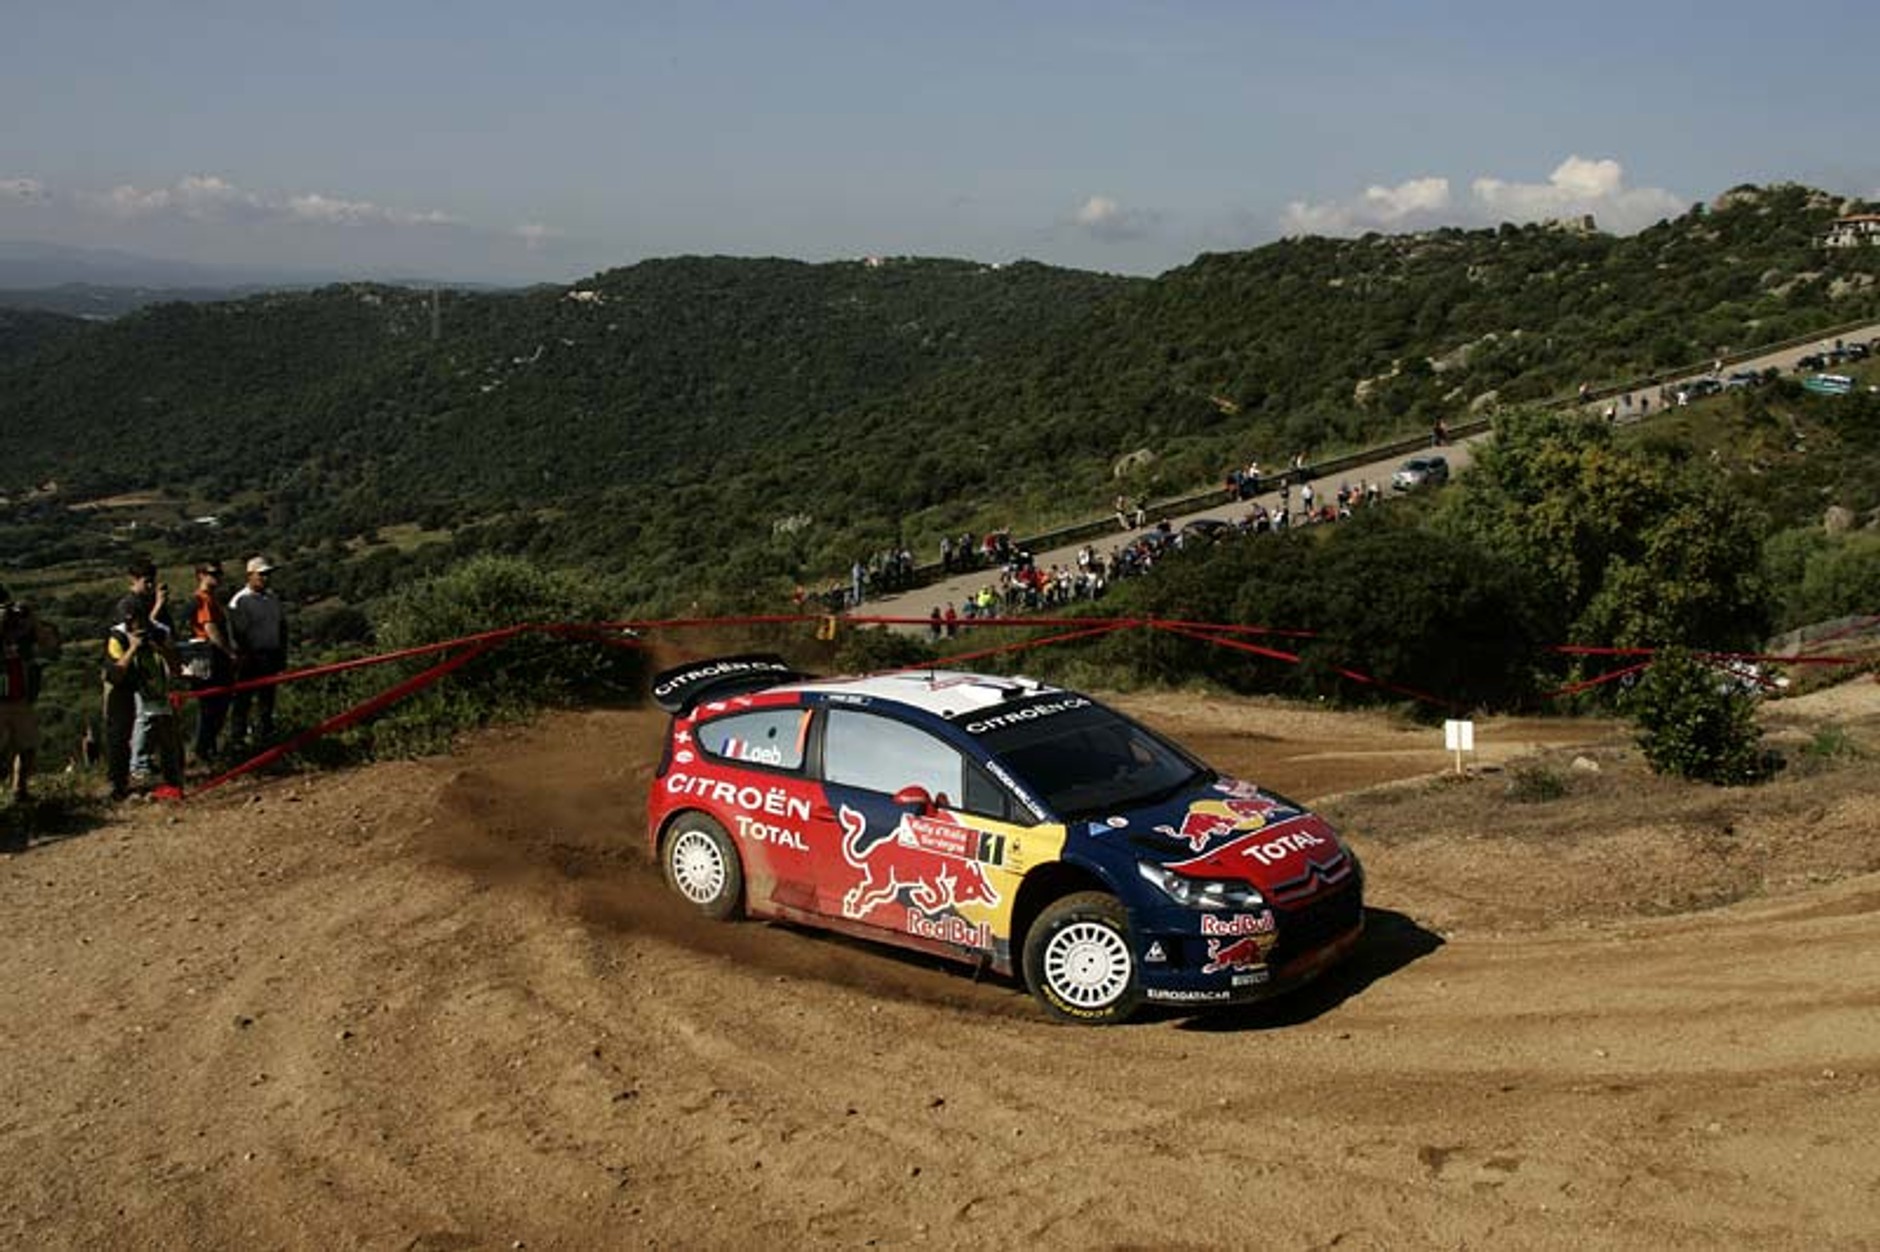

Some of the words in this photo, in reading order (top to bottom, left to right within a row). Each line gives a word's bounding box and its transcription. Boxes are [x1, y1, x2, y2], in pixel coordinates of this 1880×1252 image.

[655, 661, 750, 696] CITROËN
[966, 703, 1064, 733] CITROËN
[742, 740, 782, 764] Loeb
[667, 773, 810, 821] CITROËN
[735, 815, 810, 850] TOTAL
[984, 834, 997, 864] 1
[1242, 830, 1326, 866] TOTAL
[907, 907, 949, 939] Red
[950, 916, 993, 950] Bull
[1201, 913, 1240, 935] Red
[1240, 909, 1275, 934] Bull
